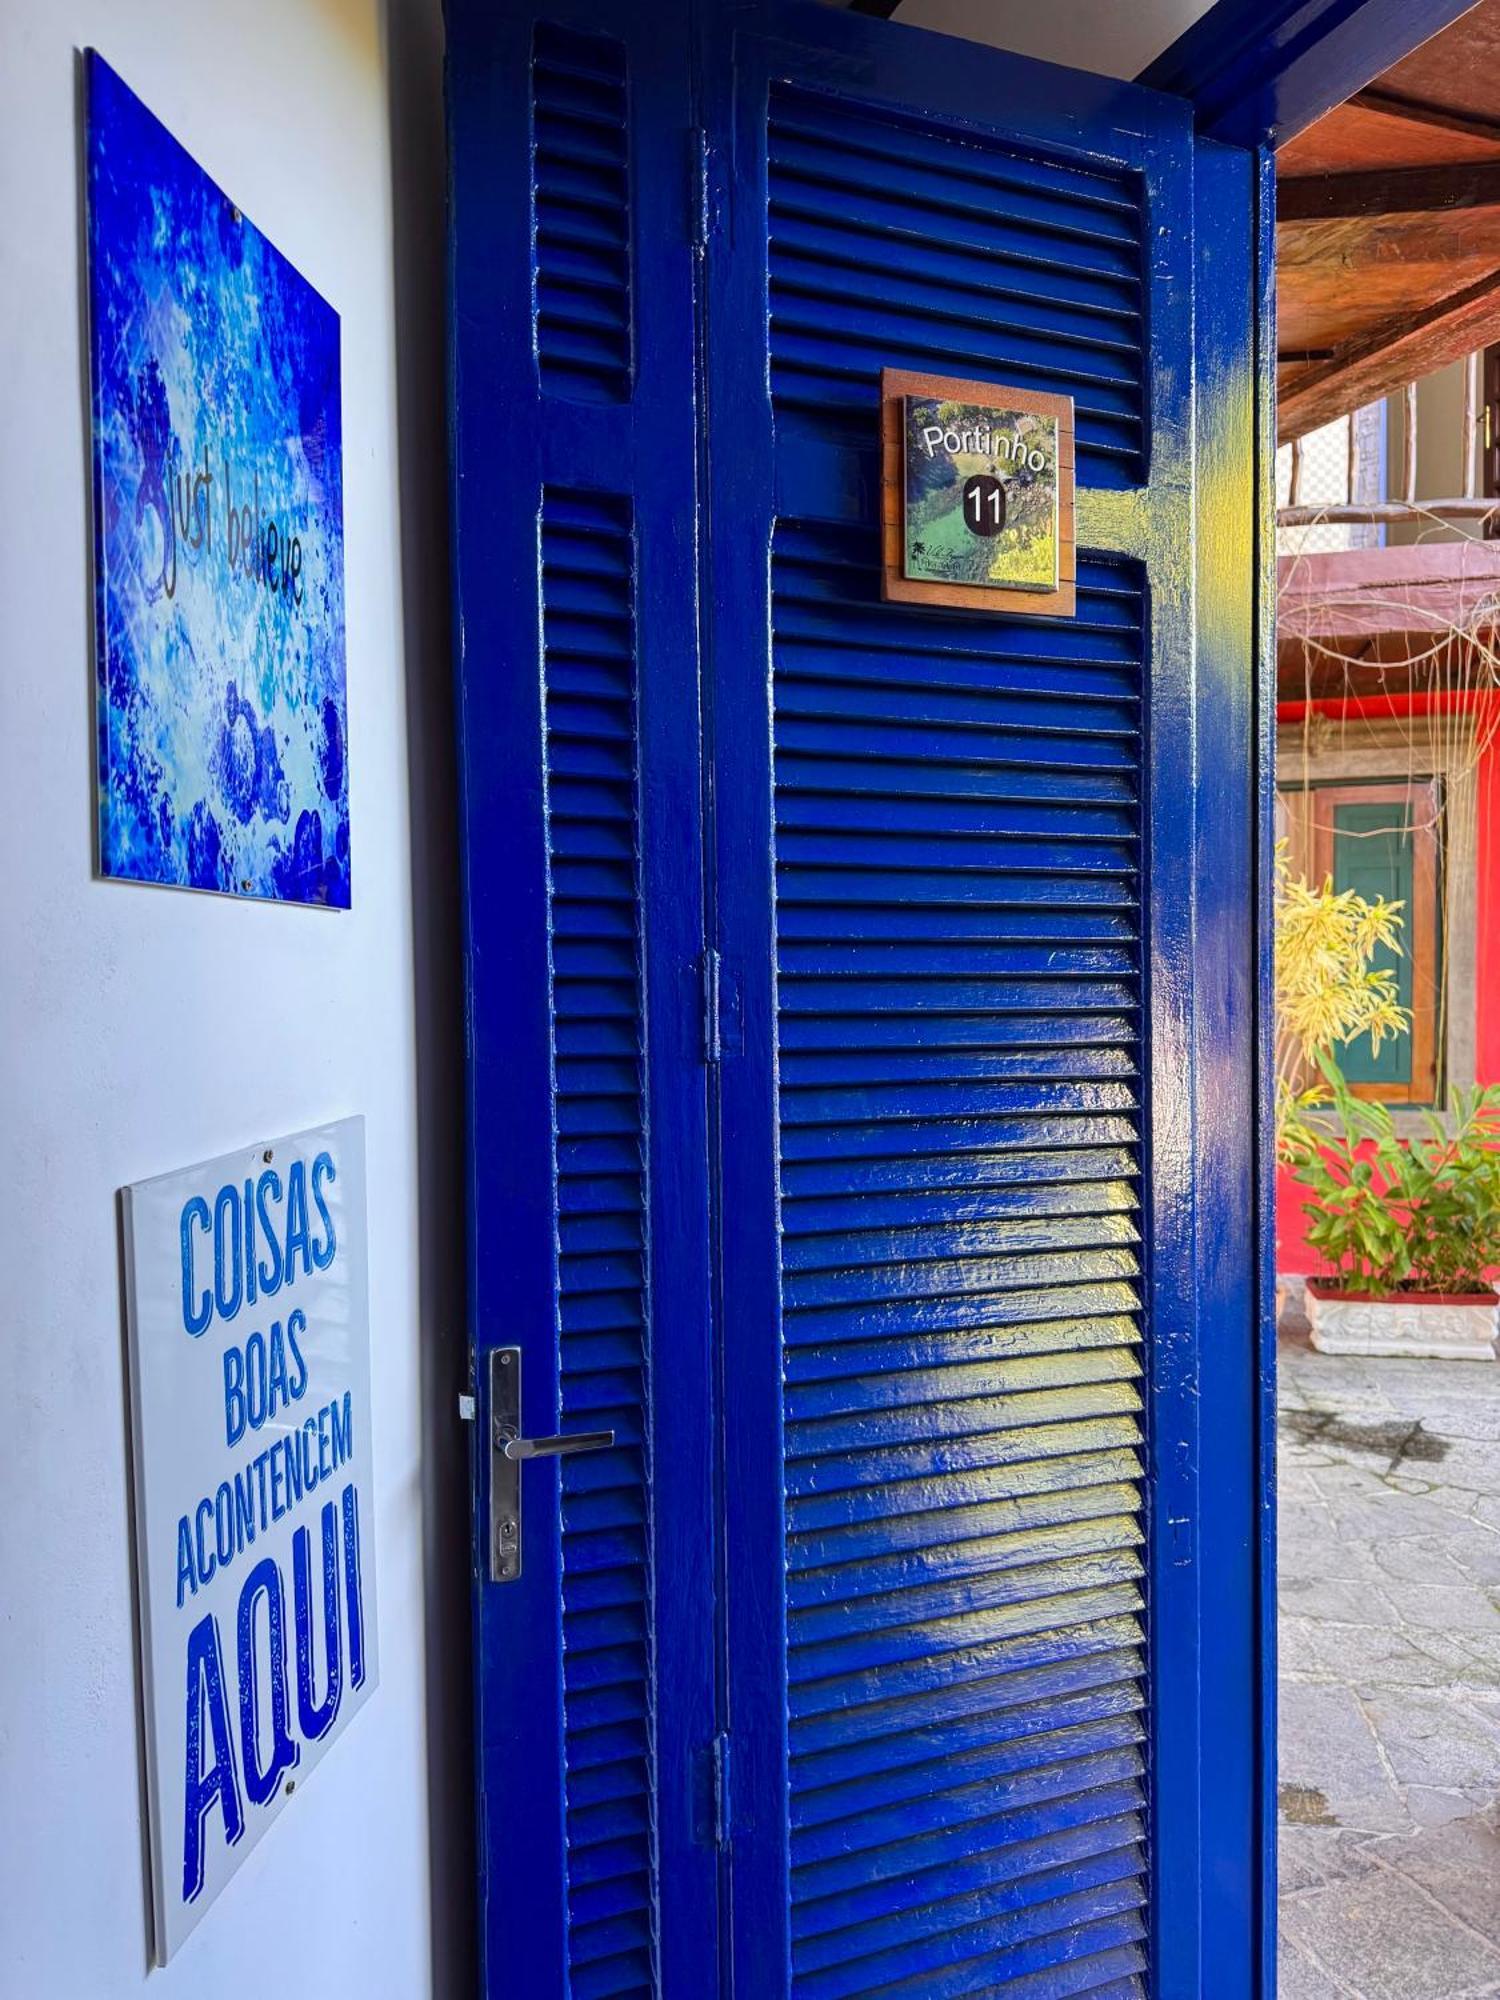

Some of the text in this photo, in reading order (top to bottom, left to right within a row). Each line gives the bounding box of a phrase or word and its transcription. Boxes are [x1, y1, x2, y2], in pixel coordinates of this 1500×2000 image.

[163, 445, 303, 606] just believe
[922, 425, 1046, 472] Portinho
[967, 485, 1001, 525] 11
[180, 1151, 336, 1338] COISAS
[223, 1308, 308, 1448] BOAS
[176, 1390, 353, 1609] ACONTENCEM
[182, 1482, 366, 1903] AQUI
